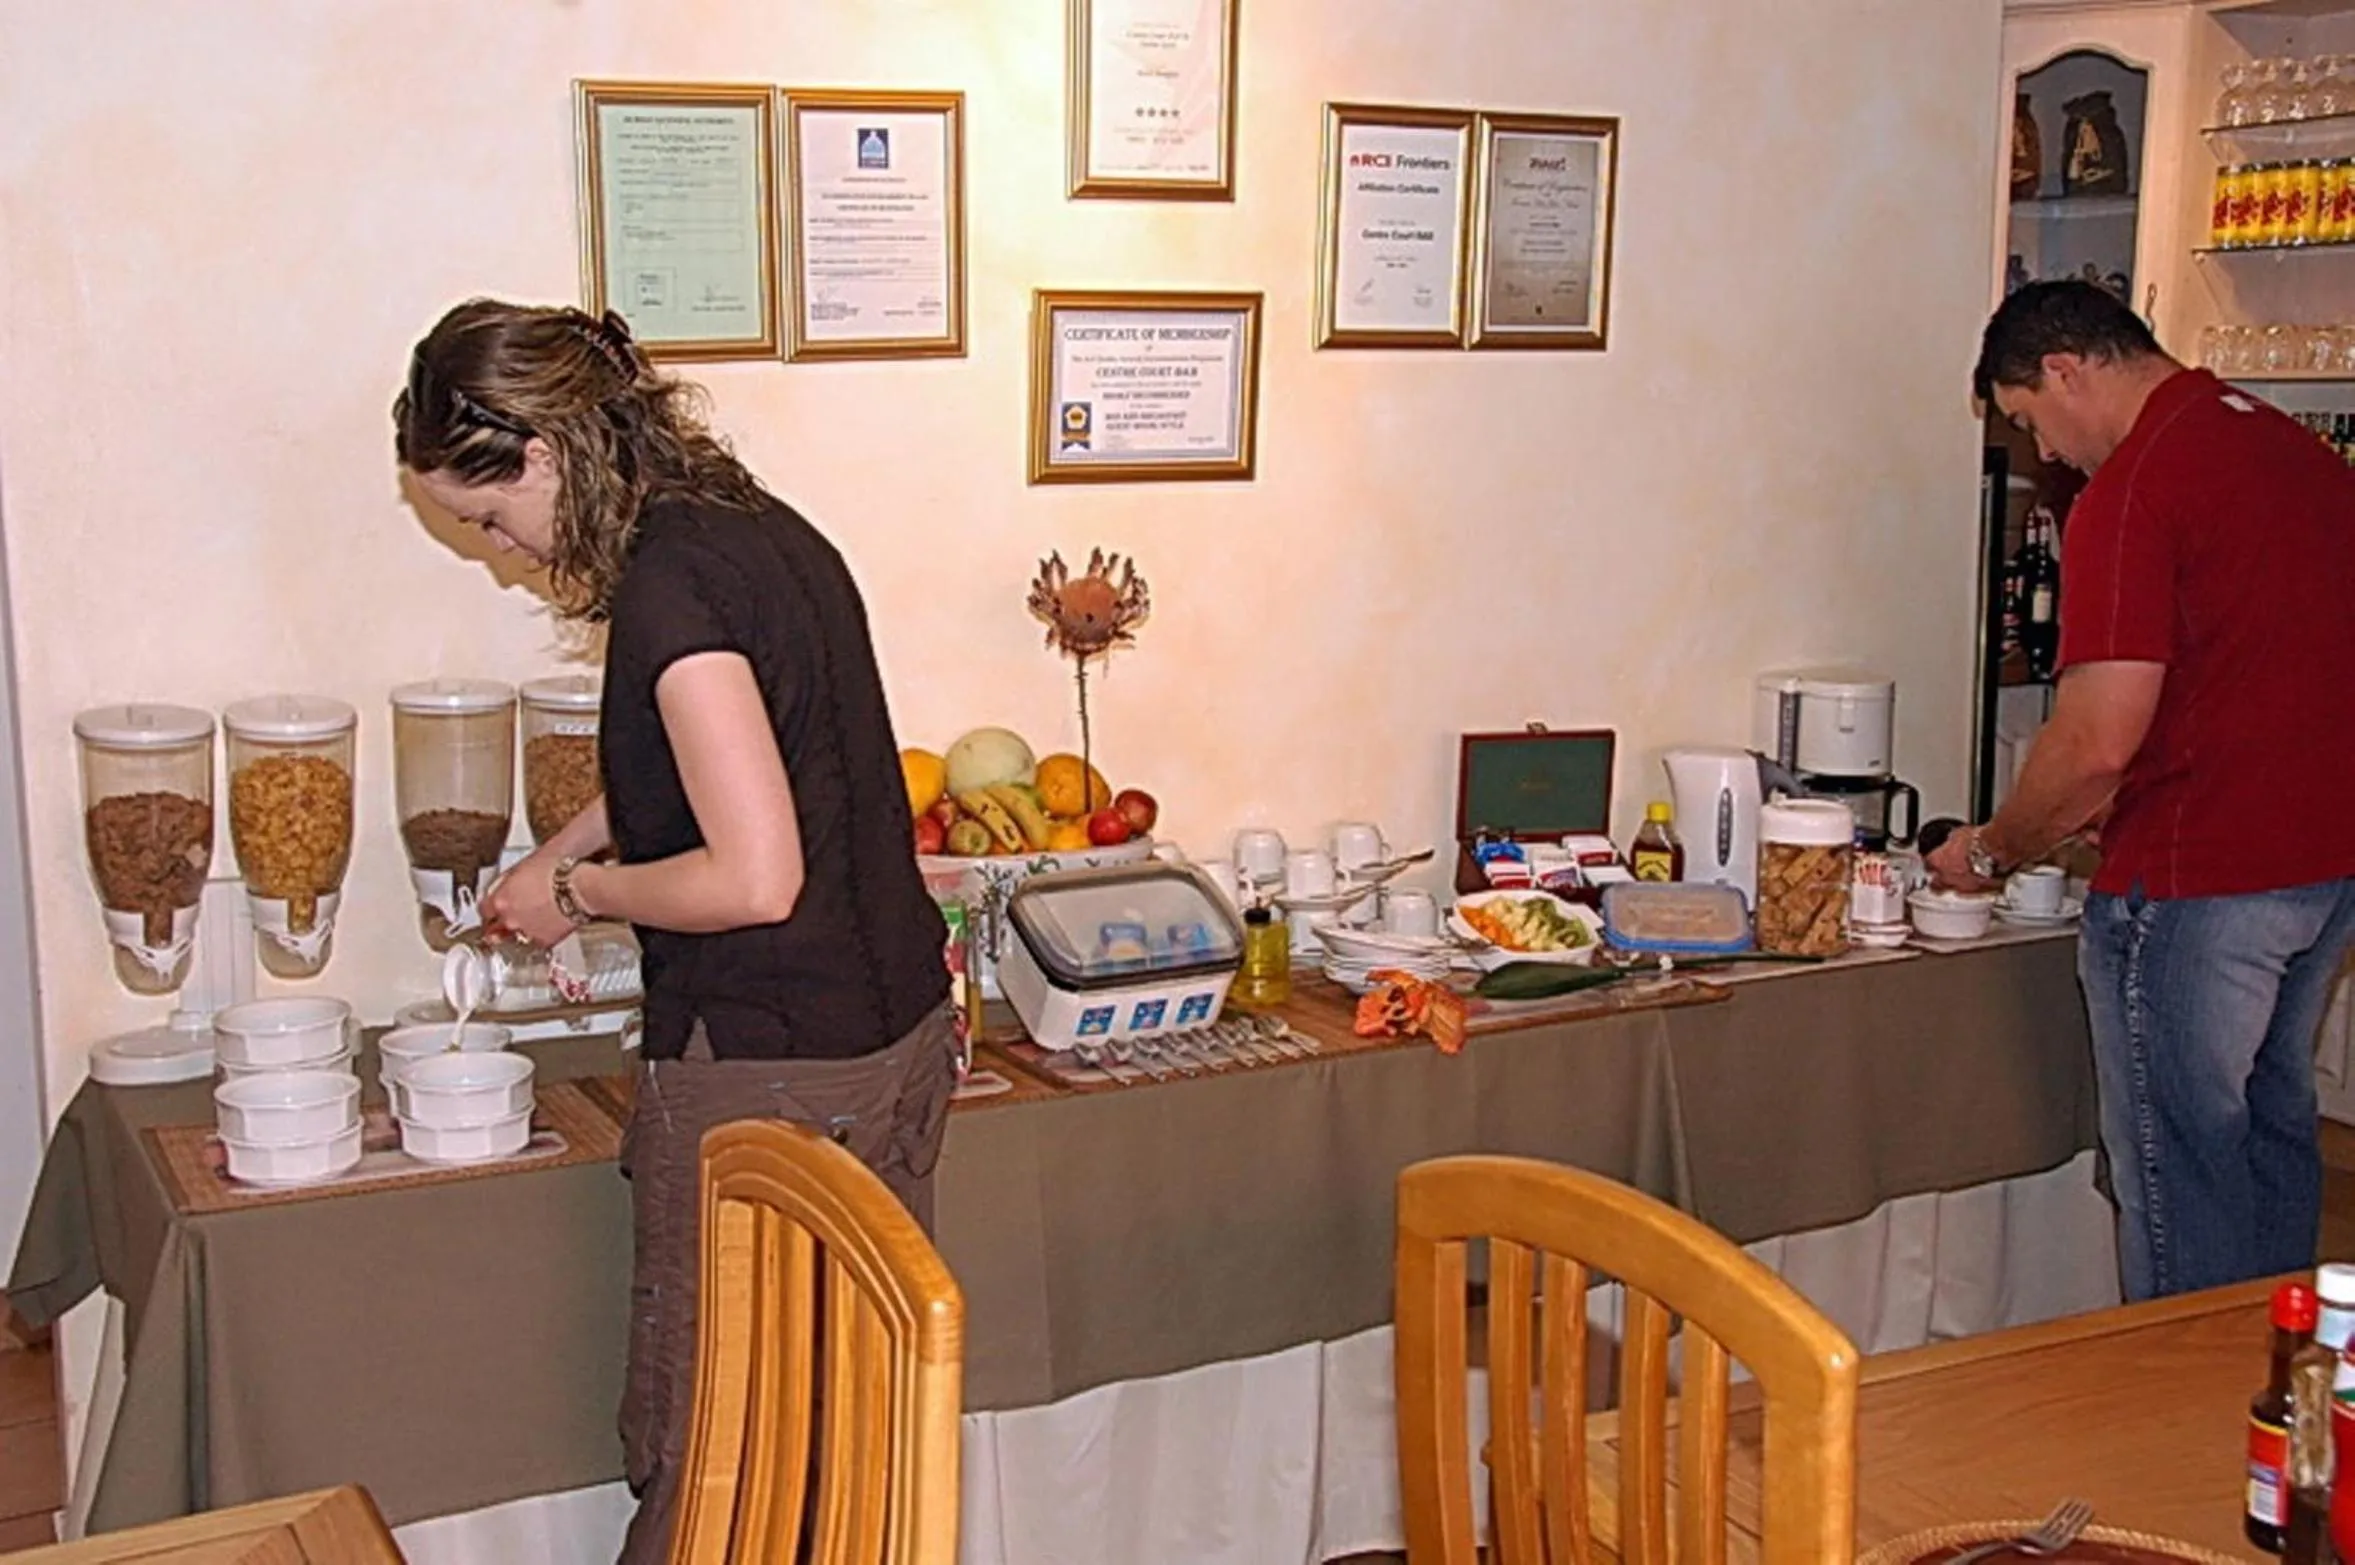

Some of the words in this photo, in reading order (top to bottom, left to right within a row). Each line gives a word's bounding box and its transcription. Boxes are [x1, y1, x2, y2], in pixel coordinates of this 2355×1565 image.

[1397, 154, 1450, 170] Frontiers
[1396, 183, 1440, 193] Certificate
[1064, 327, 1138, 340] CERTIFICATE
